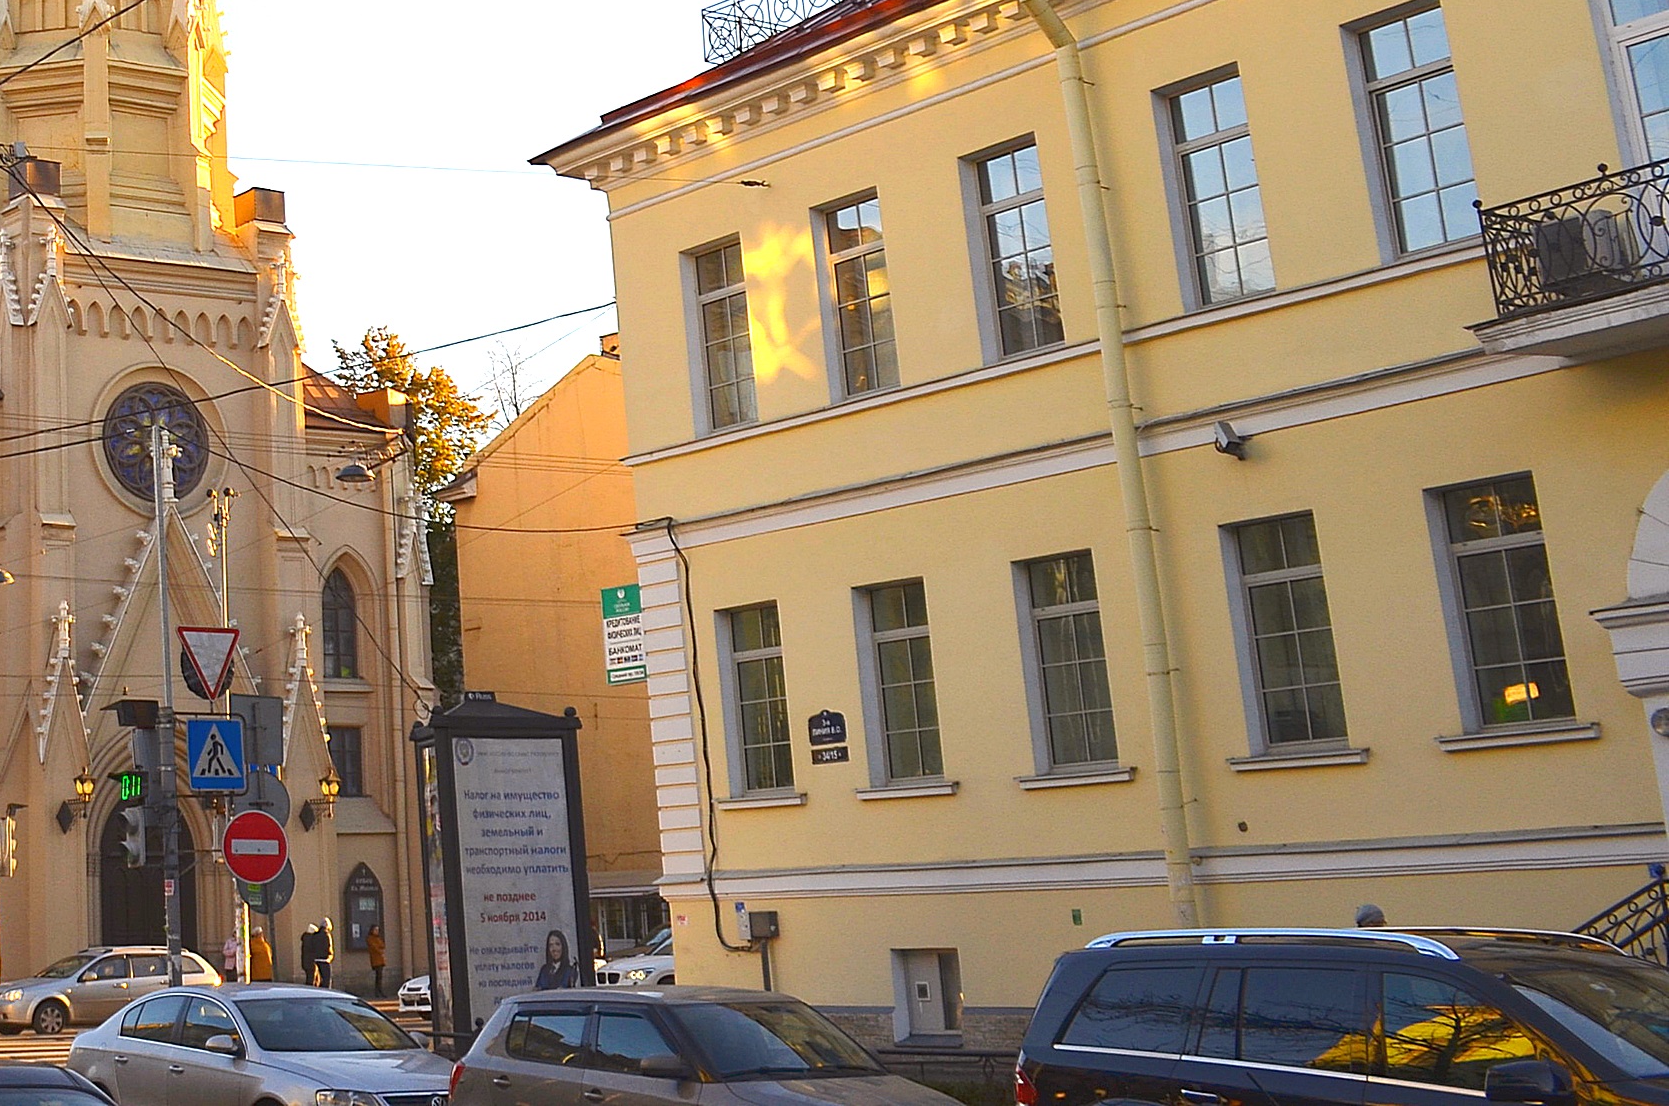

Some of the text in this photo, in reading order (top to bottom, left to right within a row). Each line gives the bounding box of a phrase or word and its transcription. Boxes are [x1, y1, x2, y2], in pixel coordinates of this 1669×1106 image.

[608, 644, 642, 656] БАНКОМАТ
[463, 789, 489, 800] Налог
[503, 791, 560, 802] имущество
[472, 808, 552, 820] физических лиц,
[481, 826, 535, 837] земельный
[464, 845, 567, 857] транспортный налоги
[466, 863, 569, 876] необходимо уплатить
[483, 893, 537, 903] не позднее
[480, 911, 547, 924] 5 ноября 2014
[480, 944, 539, 955] откладывайте
[500, 962, 535, 971] налогов
[488, 976, 533, 988] последний
